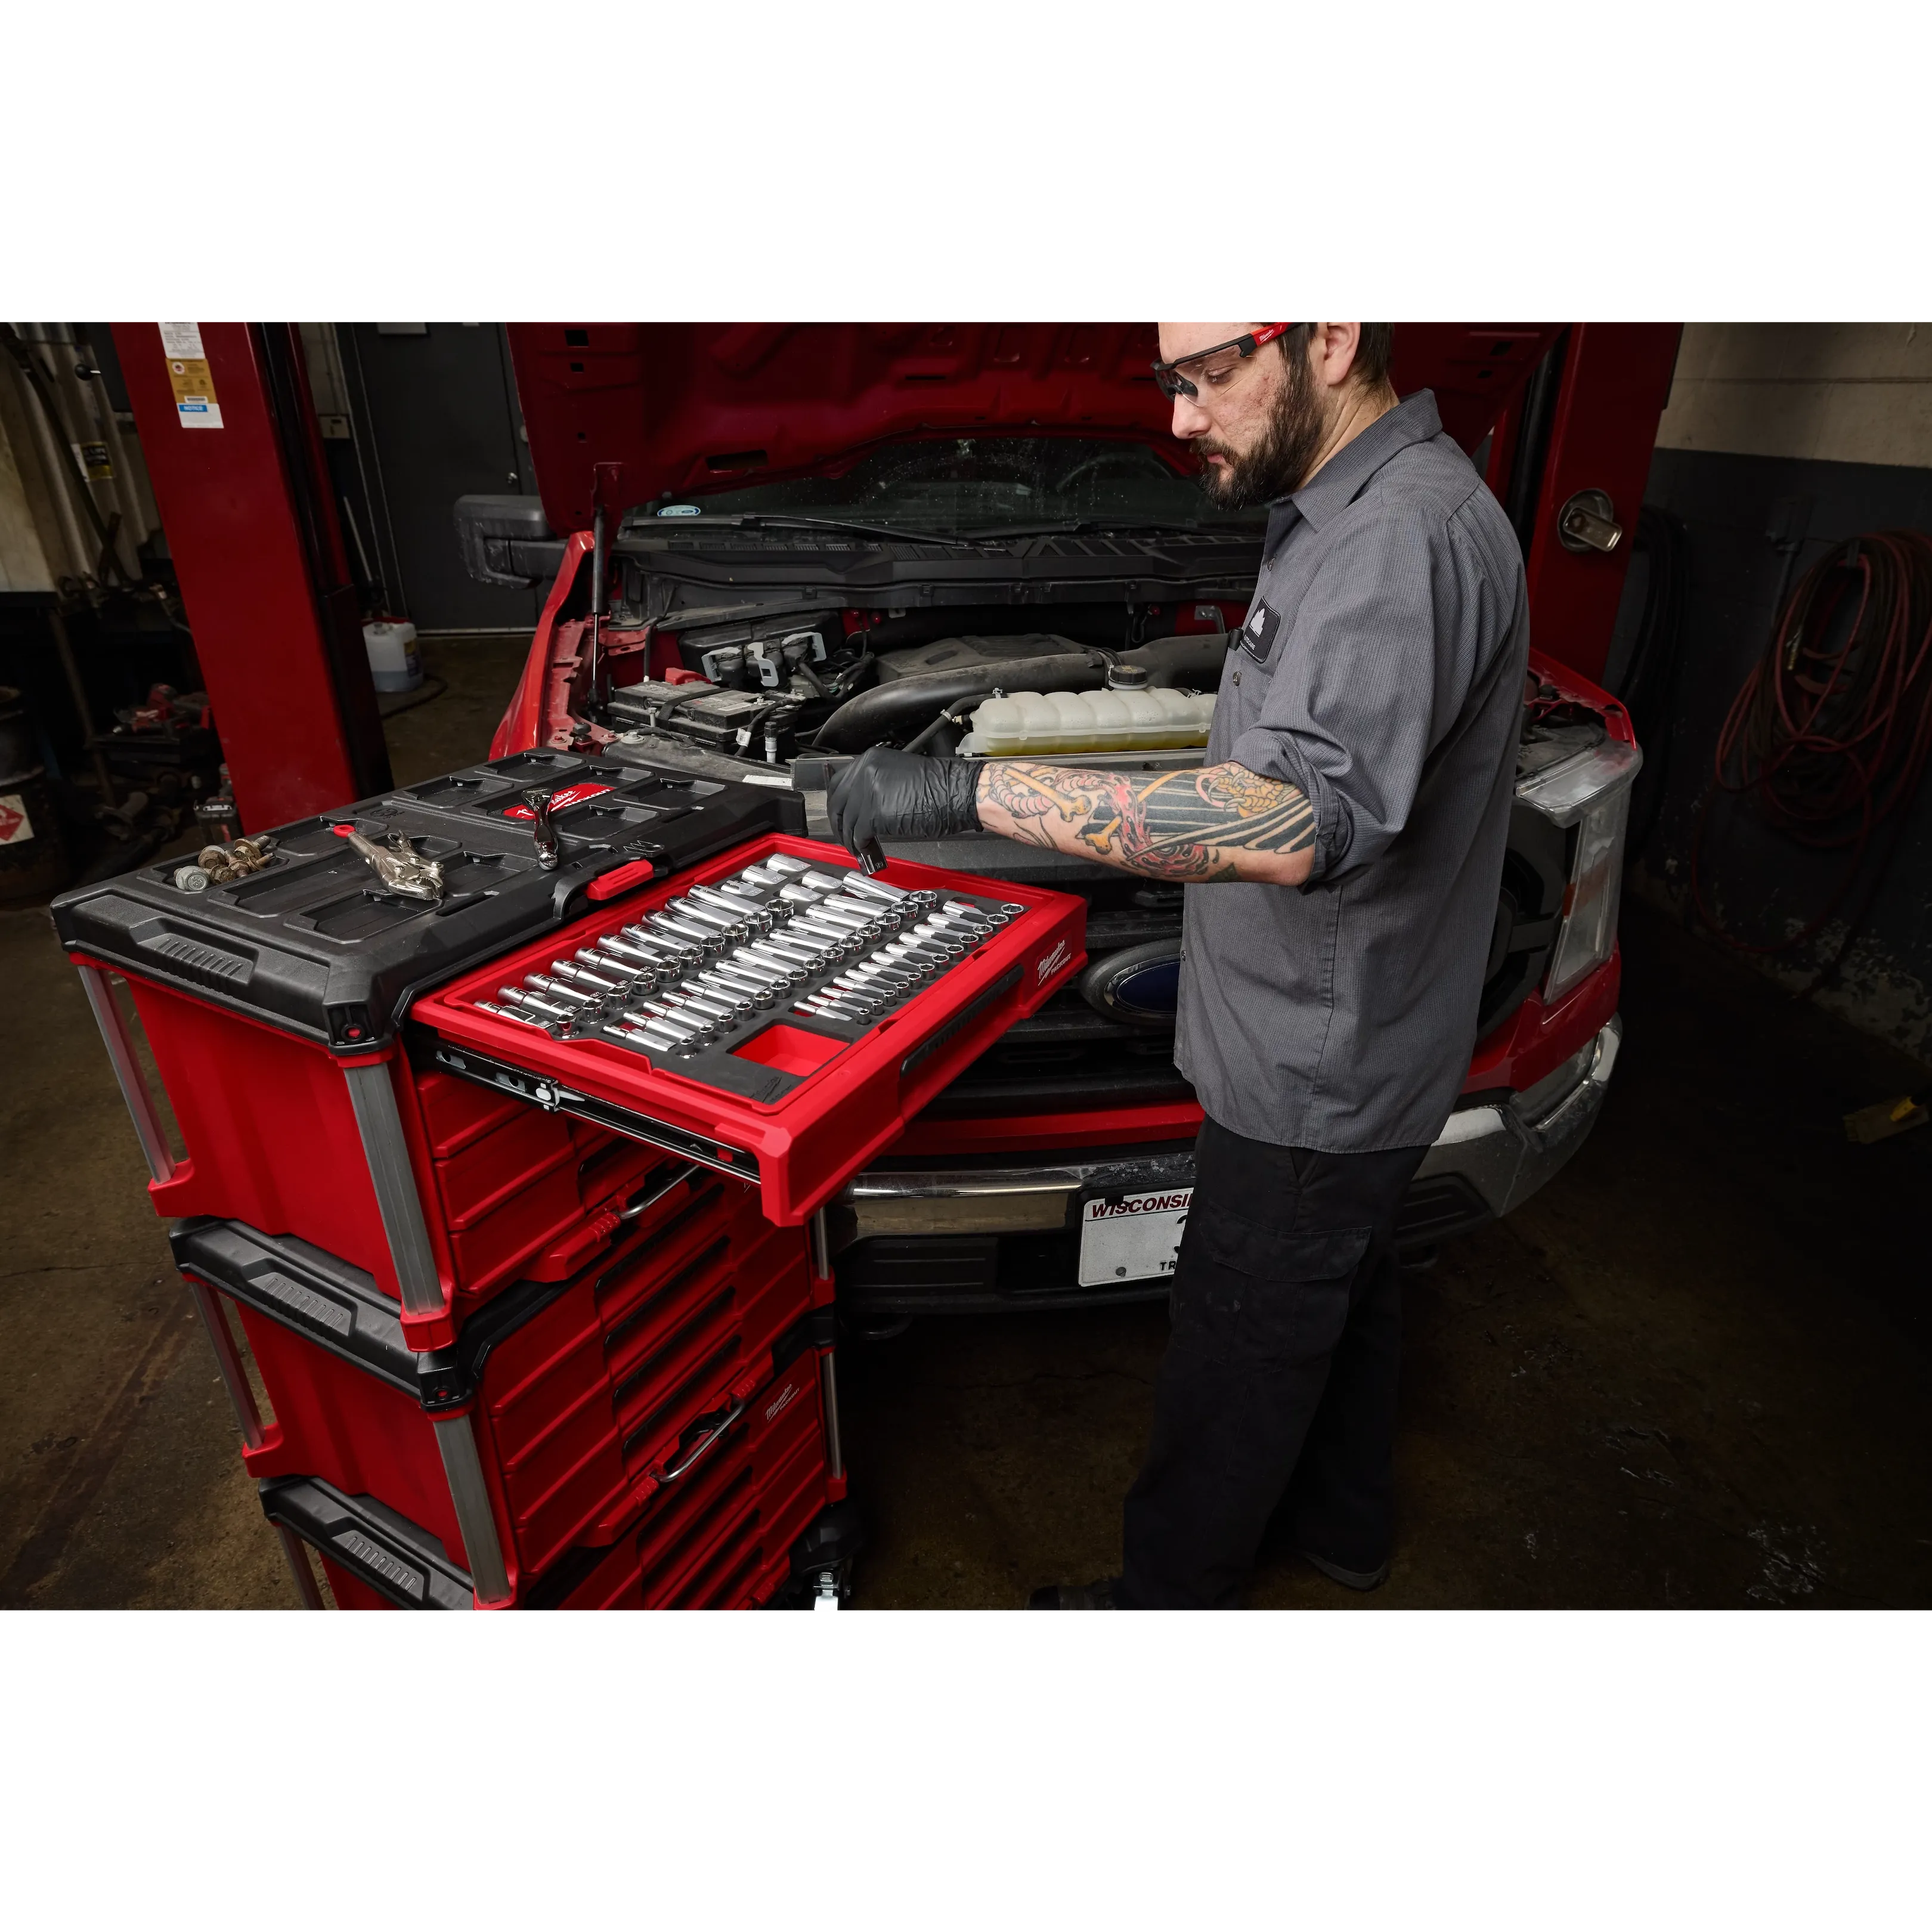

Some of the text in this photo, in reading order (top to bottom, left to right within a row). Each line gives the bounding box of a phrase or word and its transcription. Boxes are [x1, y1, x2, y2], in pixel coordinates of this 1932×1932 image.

[1037, 939, 1066, 979] Milwaukee
[1051, 953, 1072, 975] PACKOUT
[765, 1383, 792, 1420] Milwaukee
[780, 1387, 800, 1411] PACKOUT
